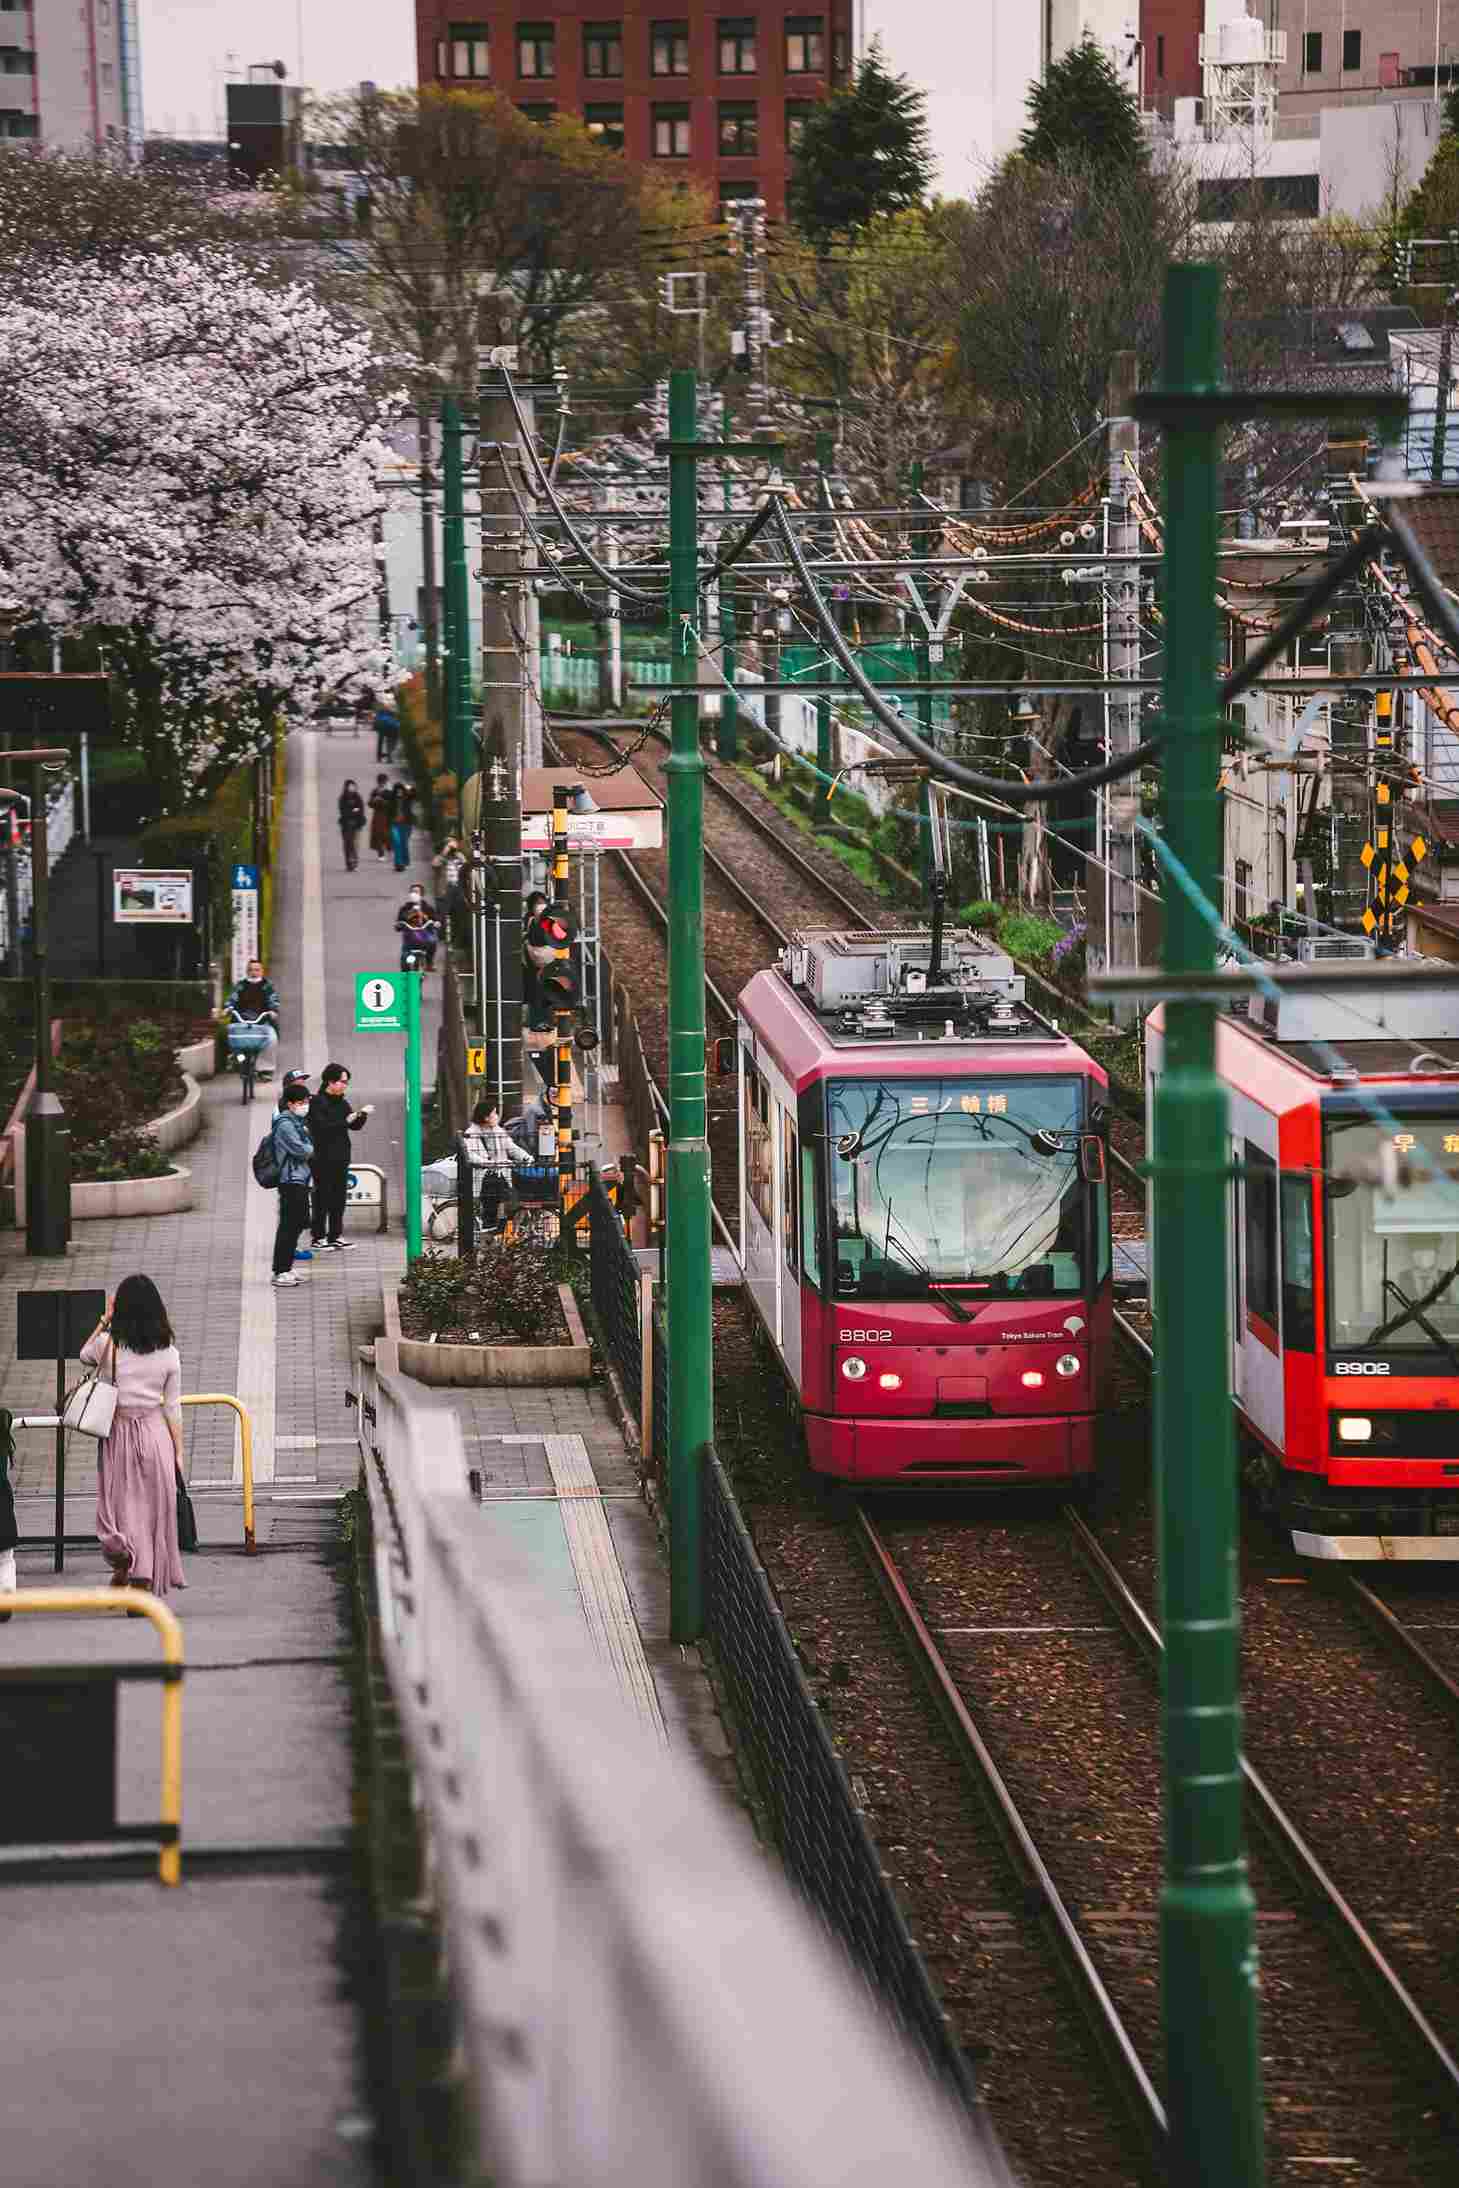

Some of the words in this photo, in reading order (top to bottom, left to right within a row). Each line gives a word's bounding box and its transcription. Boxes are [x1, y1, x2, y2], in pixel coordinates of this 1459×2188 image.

[911, 1094, 1009, 1114] 三ノ輪橋
[839, 1329, 893, 1342] 8802
[1001, 1331, 1022, 1341] Tokyo
[1335, 1362, 1391, 1375] 8902
